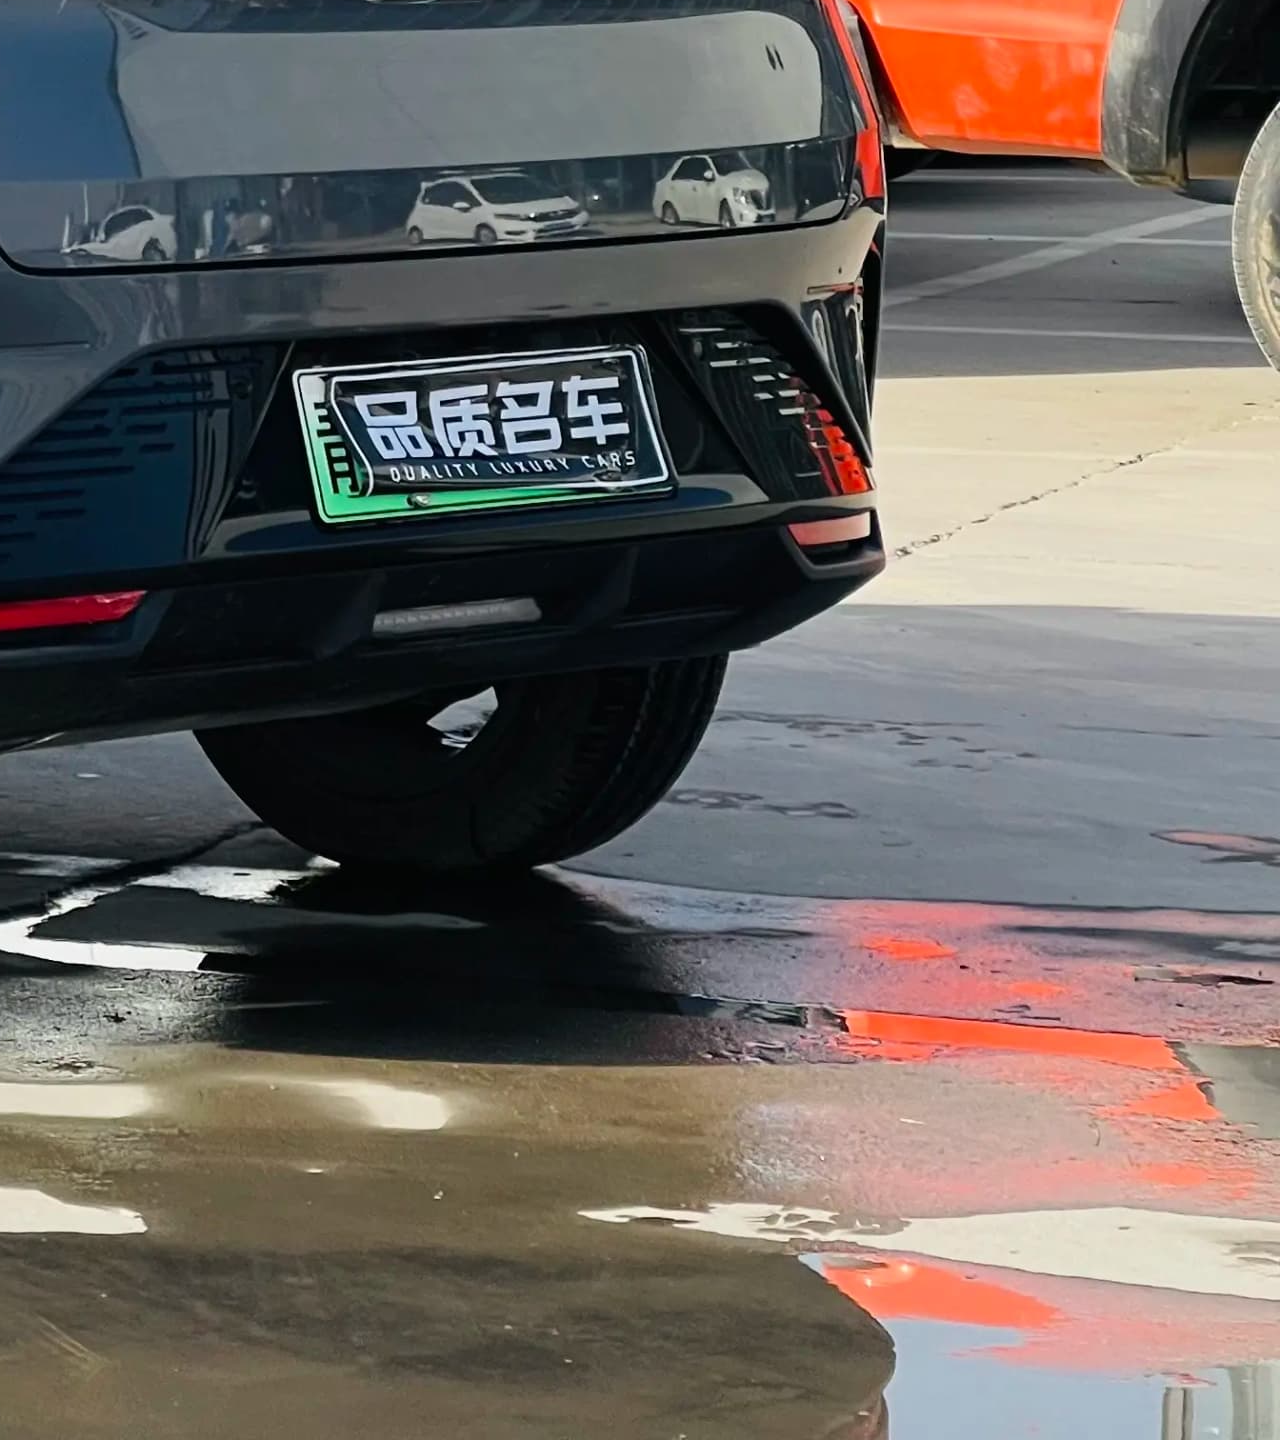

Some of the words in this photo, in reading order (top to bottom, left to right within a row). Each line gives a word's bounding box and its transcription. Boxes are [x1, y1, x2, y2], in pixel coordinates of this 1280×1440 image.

[353, 375, 631, 460] 品质名车
[389, 462, 480, 483] QUALITY
[490, 457, 571, 475] LUXURY
[581, 450, 637, 469] CARS
